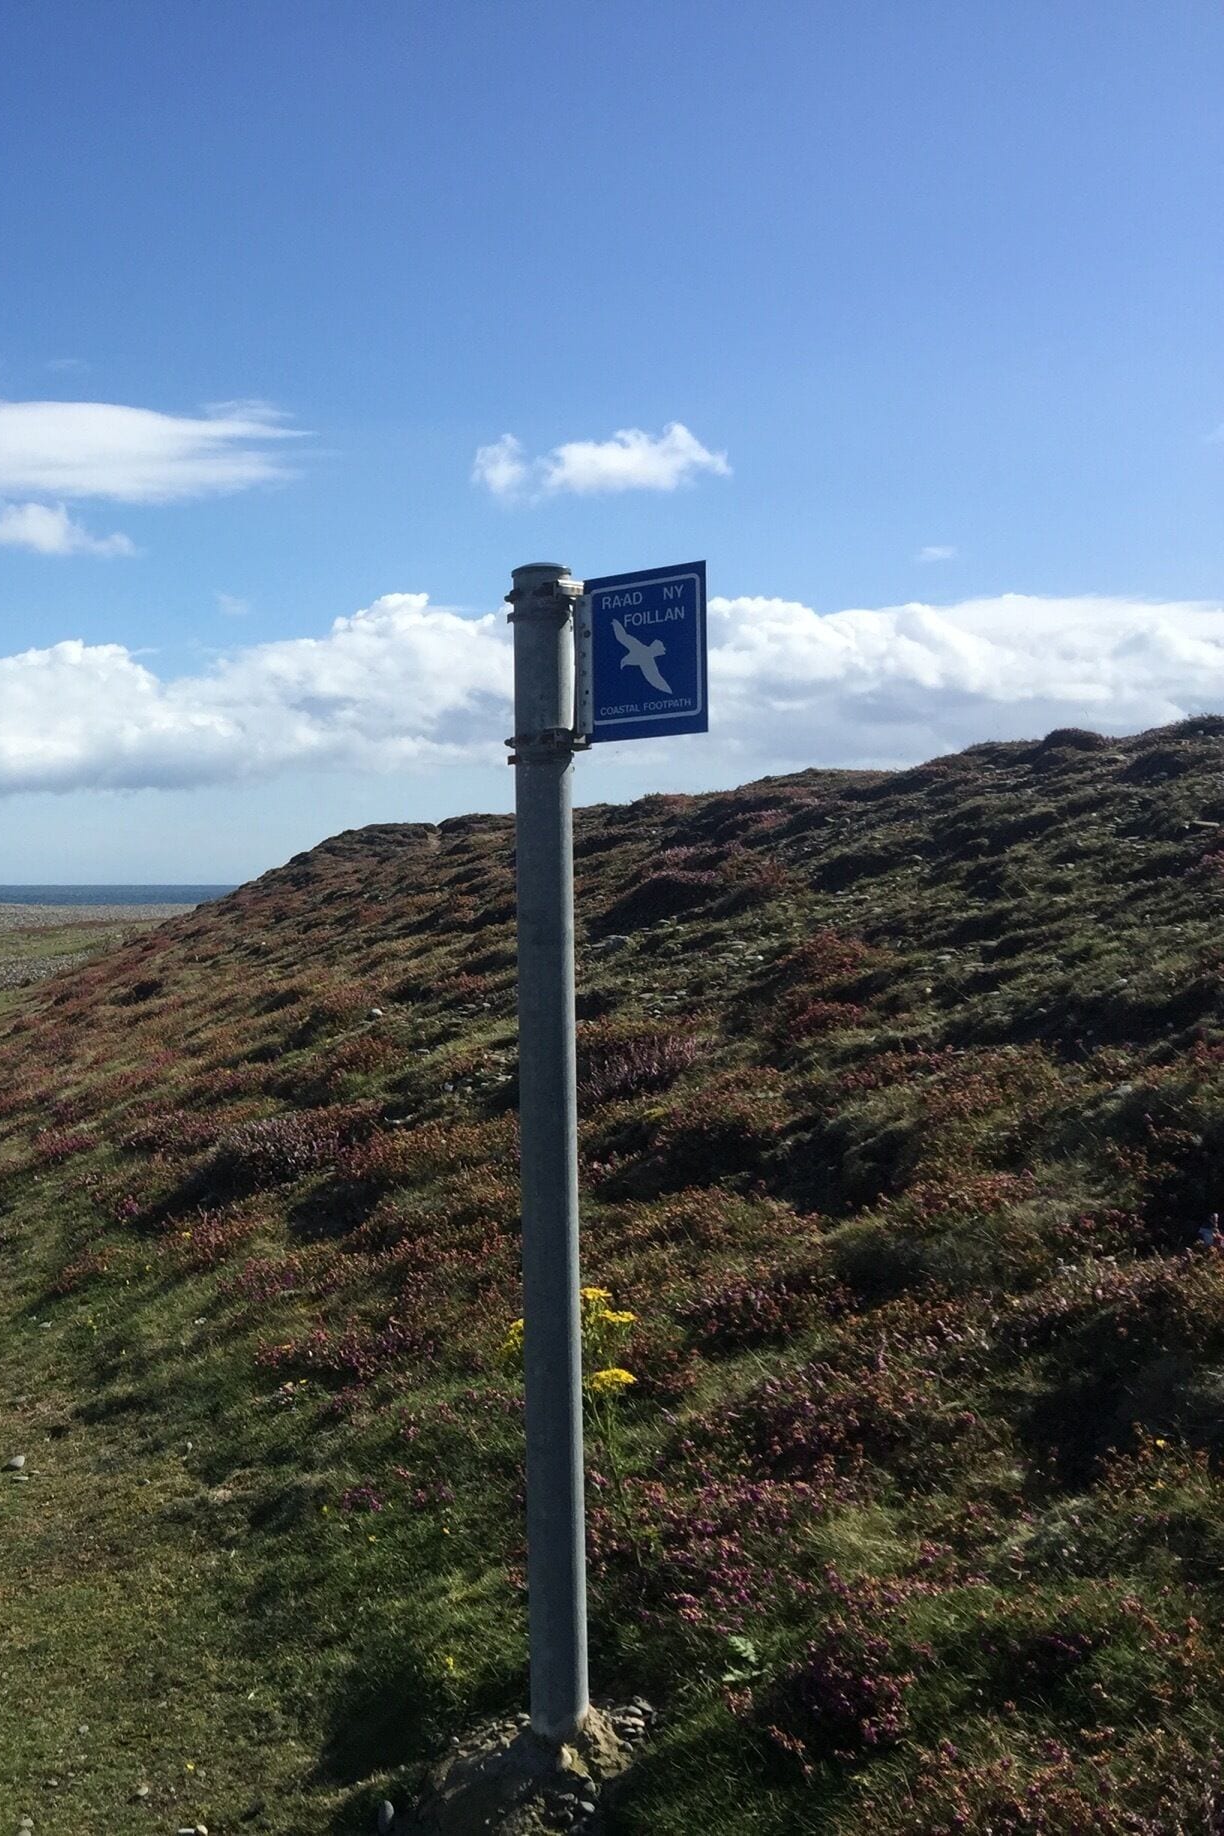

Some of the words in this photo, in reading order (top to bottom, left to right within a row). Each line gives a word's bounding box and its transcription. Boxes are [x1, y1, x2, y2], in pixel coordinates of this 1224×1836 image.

[663, 584, 684, 600] NY
[624, 606, 685, 628] FOILLAN
[600, 704, 640, 716] COASTAL
[644, 698, 691, 711] FOOTPATH
